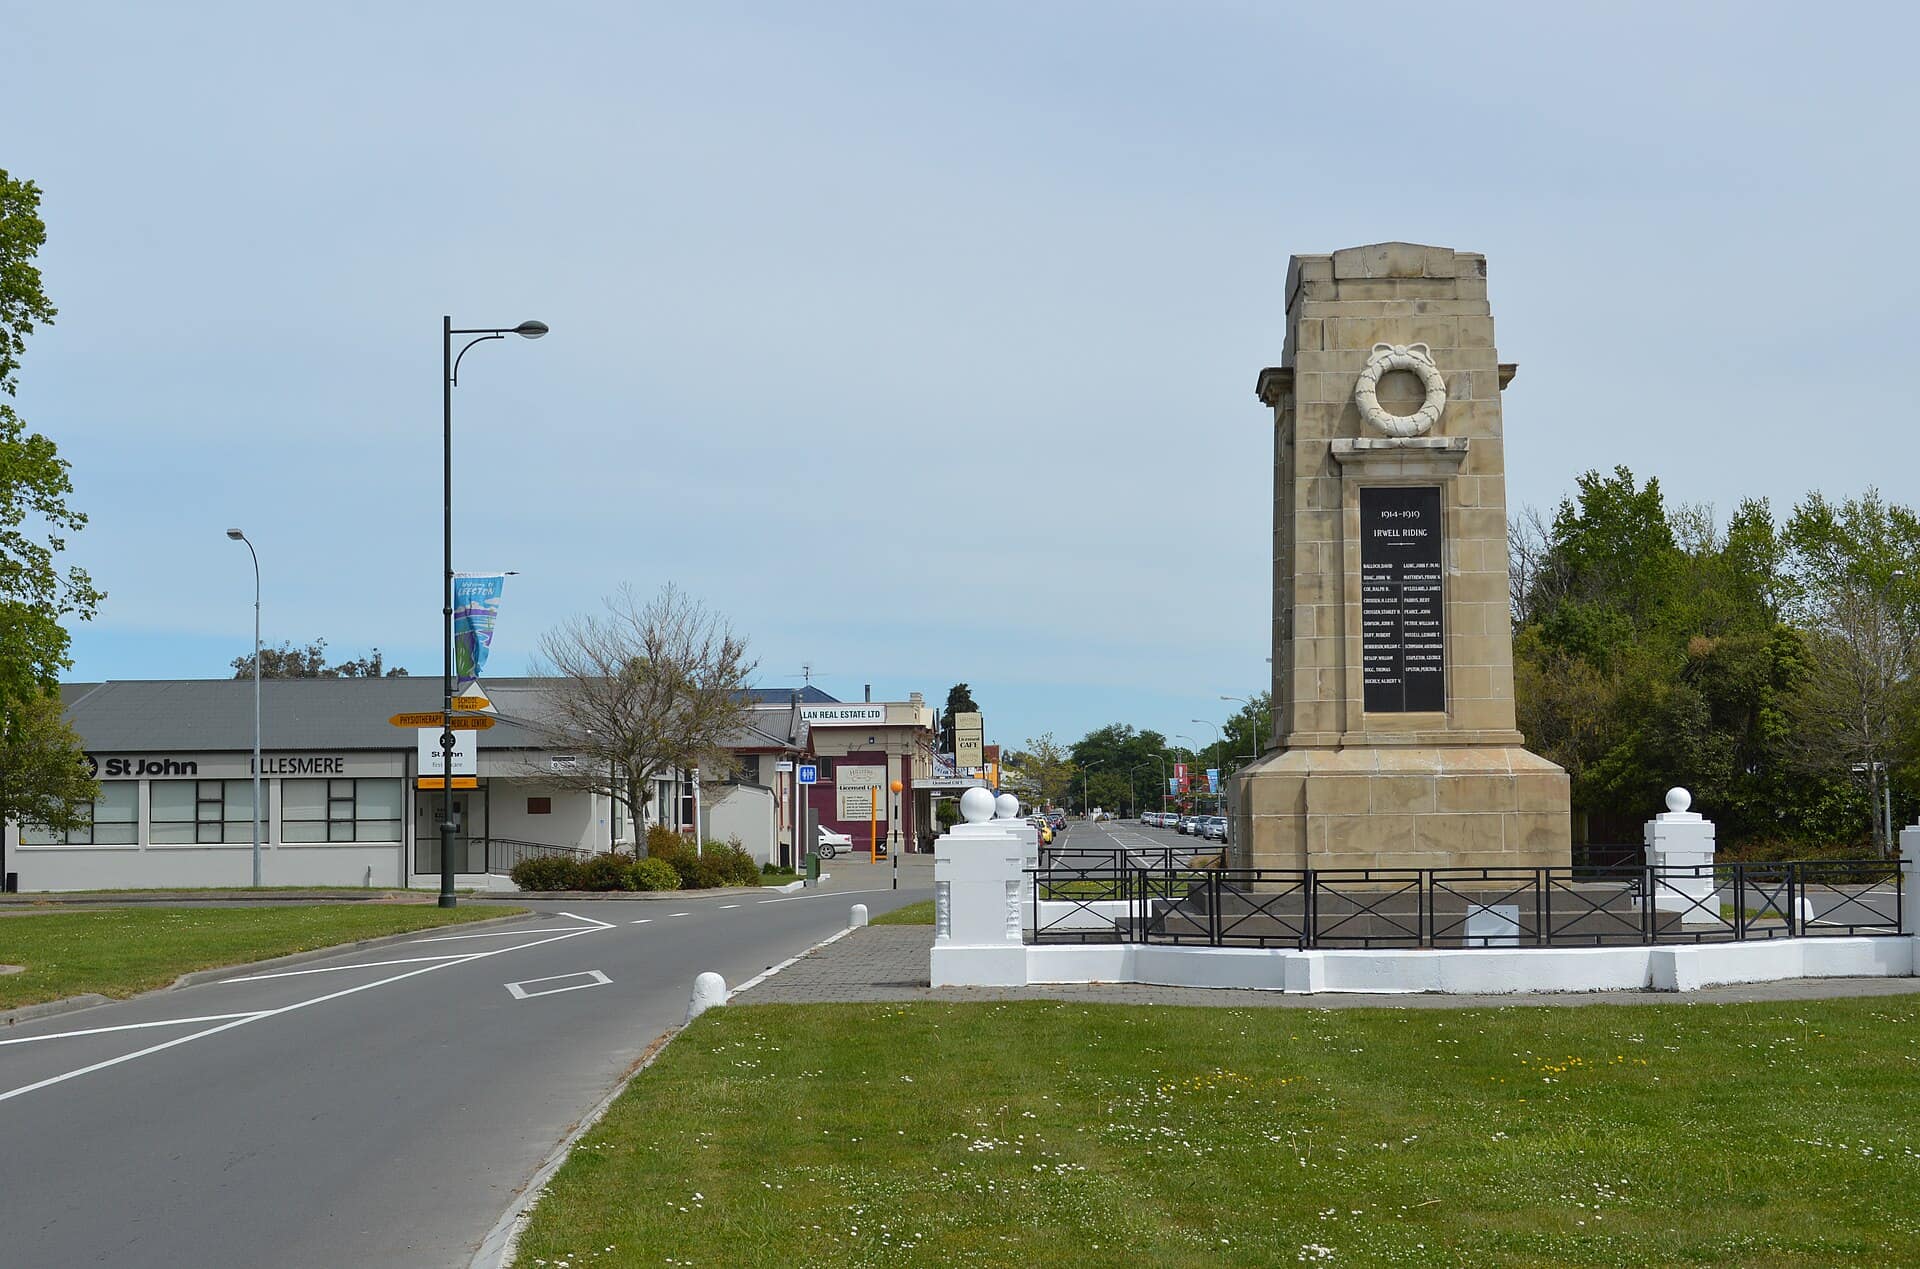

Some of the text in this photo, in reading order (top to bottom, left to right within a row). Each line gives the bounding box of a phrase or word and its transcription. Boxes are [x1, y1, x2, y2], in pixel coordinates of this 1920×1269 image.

[1381, 510, 1420, 519] 1914-1919
[1374, 528, 1428, 537] IRWELL RIDING
[400, 715, 443, 724] PHYSIOTHERAPY
[106, 758, 197, 776] St John
